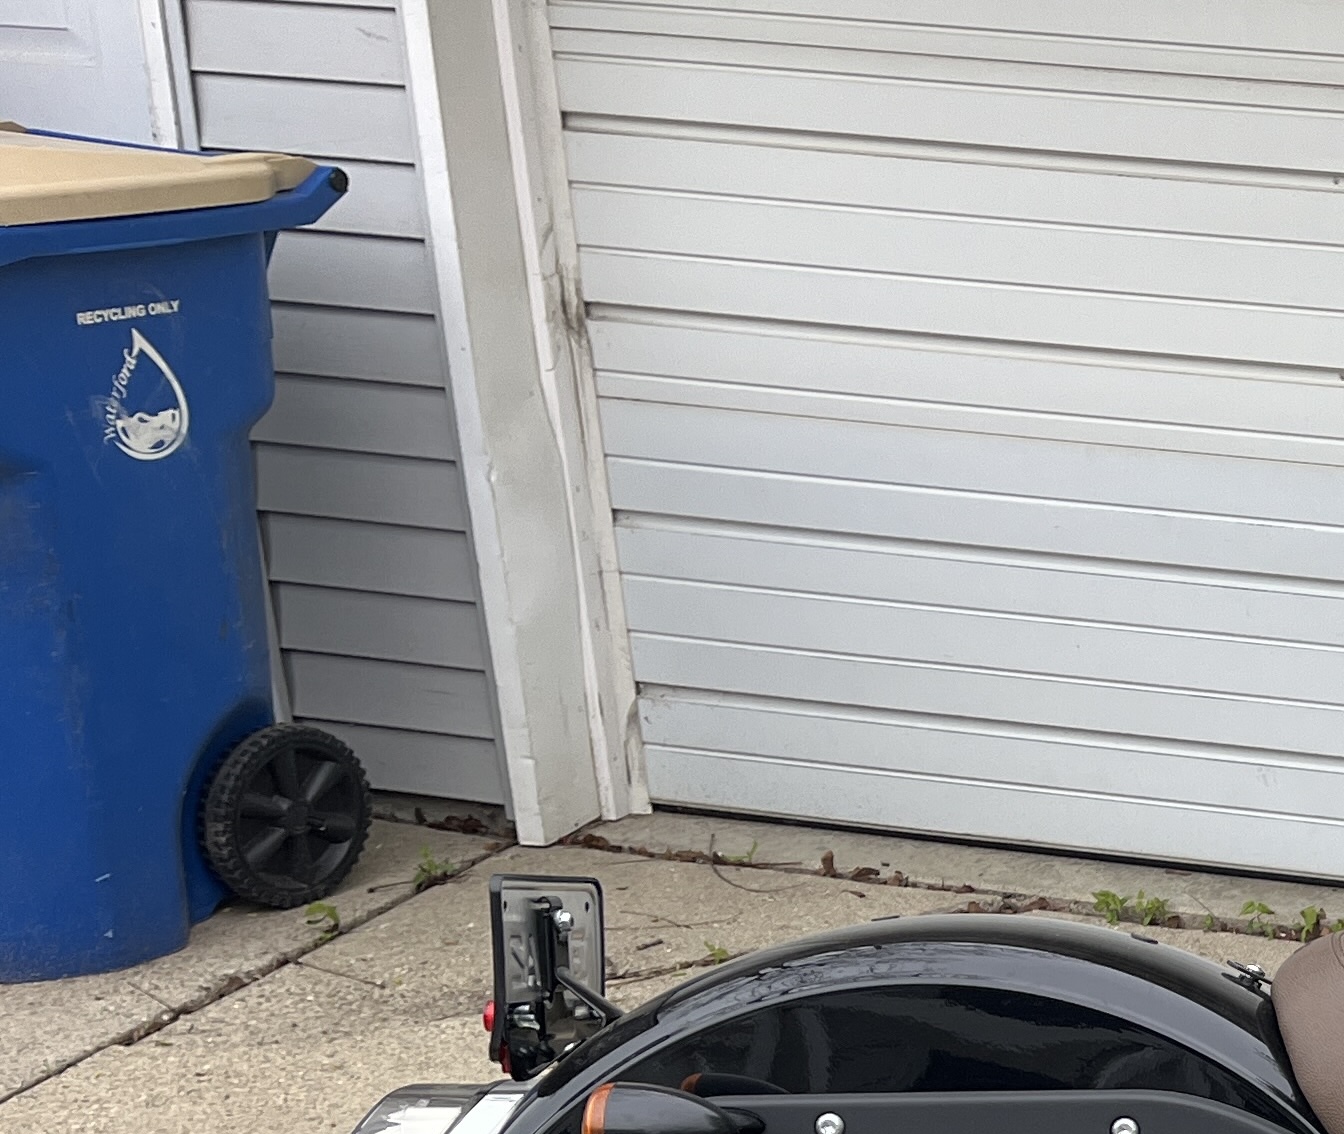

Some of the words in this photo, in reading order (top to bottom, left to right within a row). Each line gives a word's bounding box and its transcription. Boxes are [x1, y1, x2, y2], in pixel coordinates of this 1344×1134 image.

[76, 304, 147, 326] RECYCLING
[148, 300, 181, 316] ONLY
[104, 347, 139, 444] Waterford
